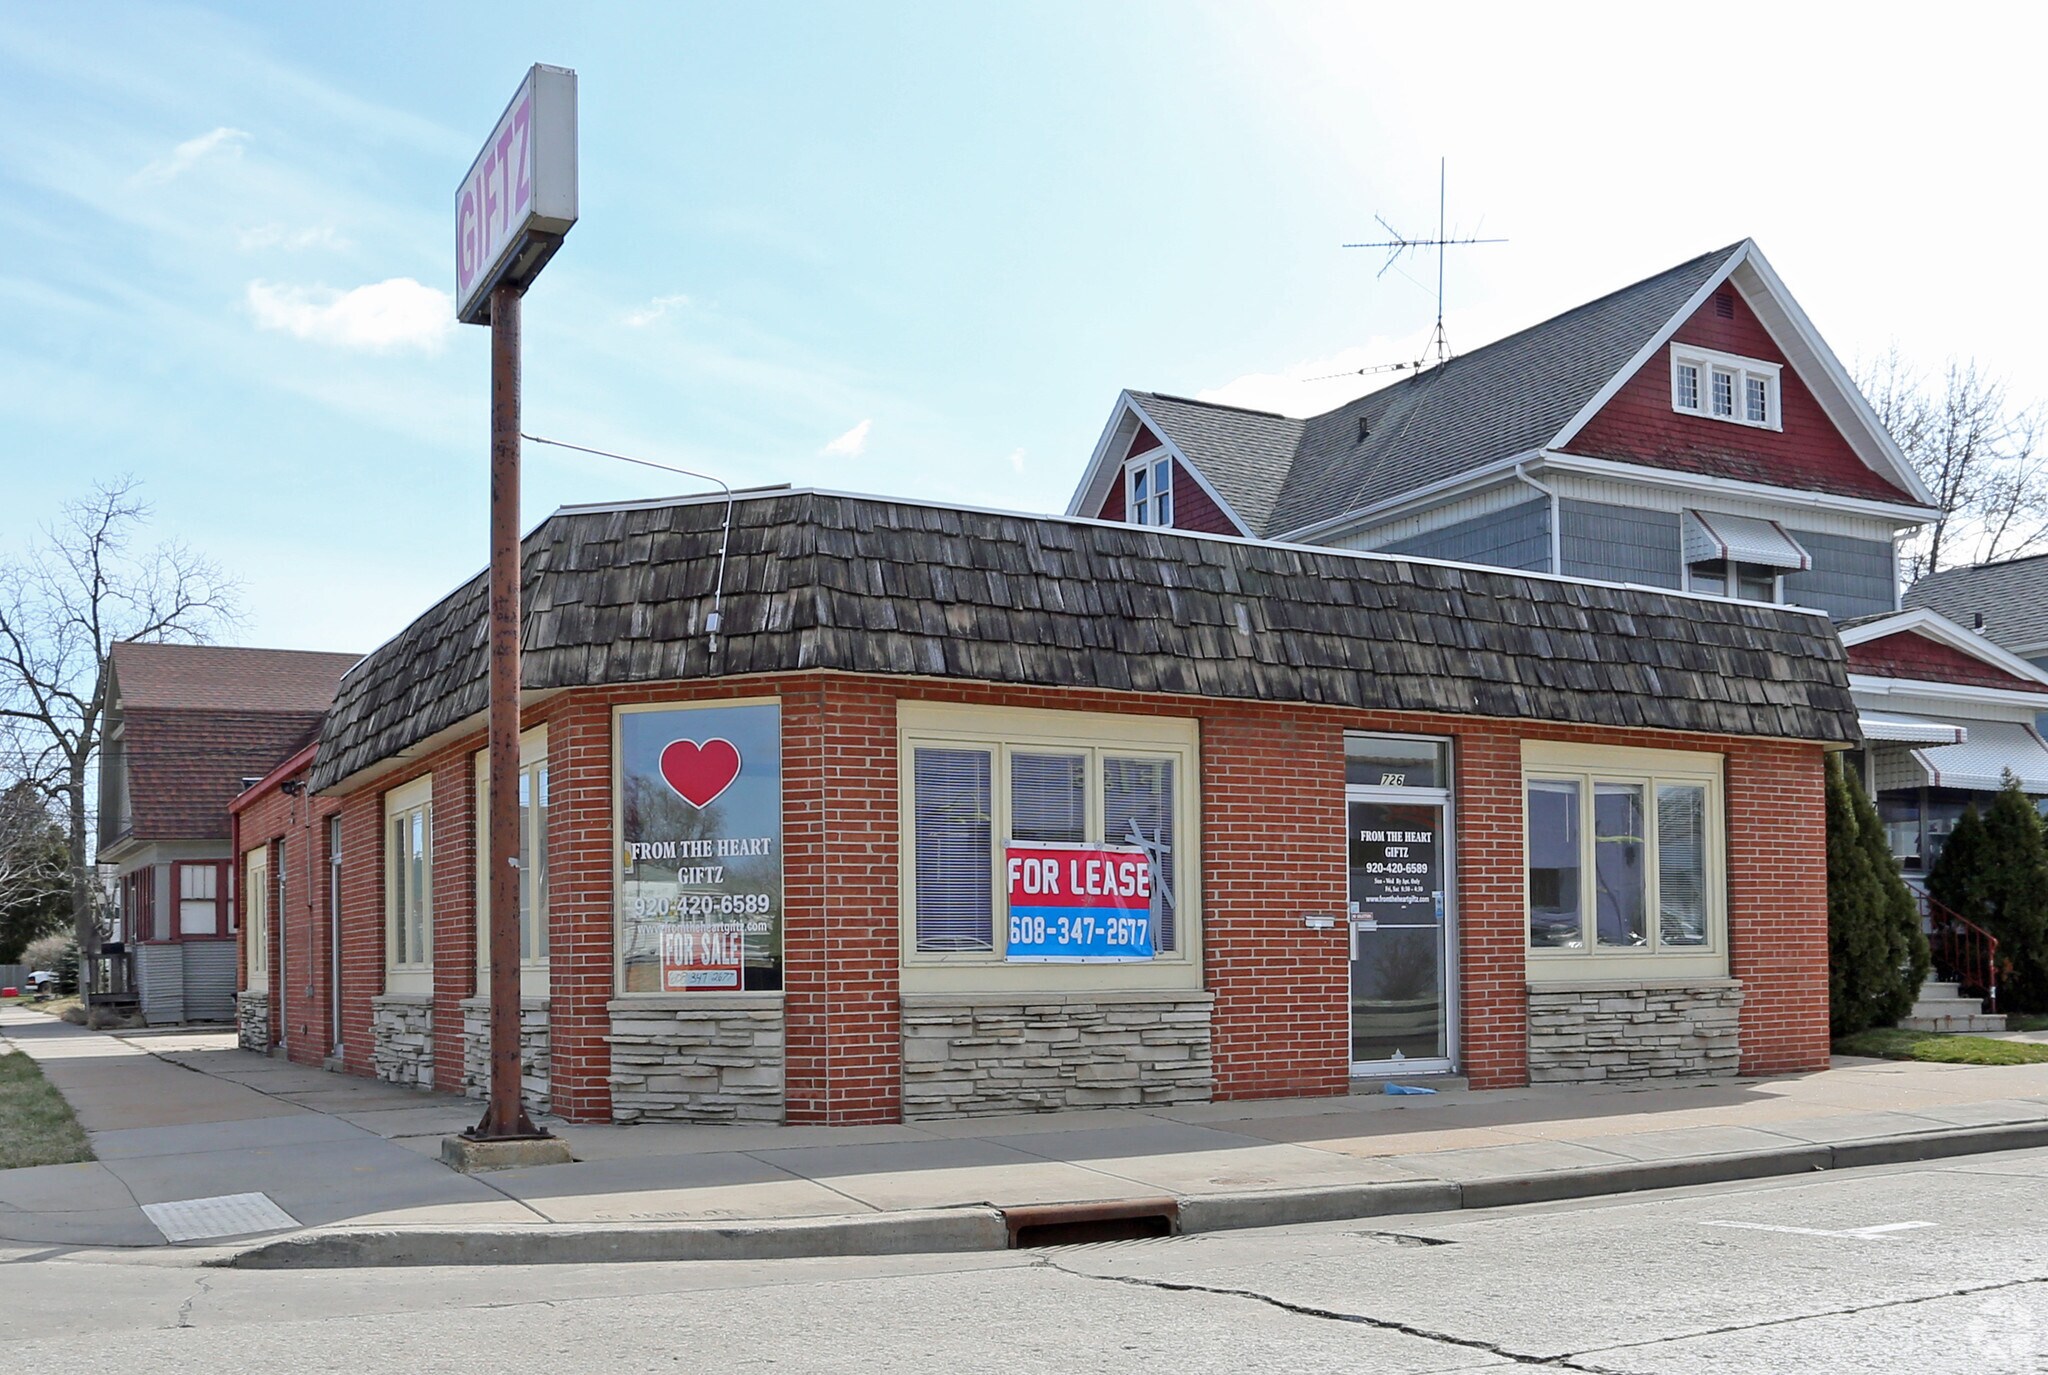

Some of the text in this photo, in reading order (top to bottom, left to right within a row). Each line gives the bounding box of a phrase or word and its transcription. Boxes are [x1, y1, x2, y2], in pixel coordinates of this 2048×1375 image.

[459, 96, 530, 291] GIFTZ
[1382, 774, 1403, 786] 726
[1360, 830, 1432, 843] FROM THE HEART
[631, 838, 771, 860] FROM THE HEART
[1384, 846, 1409, 858] GIFTZ
[677, 866, 724, 885] GIFTZ
[1008, 857, 1150, 898] FOR LEASE
[1366, 862, 1428, 874] 920-420-6589
[634, 893, 770, 916] 920-420-6589
[637, 920, 768, 936] www.fromtheheartgiftz.com
[1011, 916, 1148, 946] 608-347-2677
[665, 932, 740, 966] FOR SALE
[690, 971, 708, 984] 347
